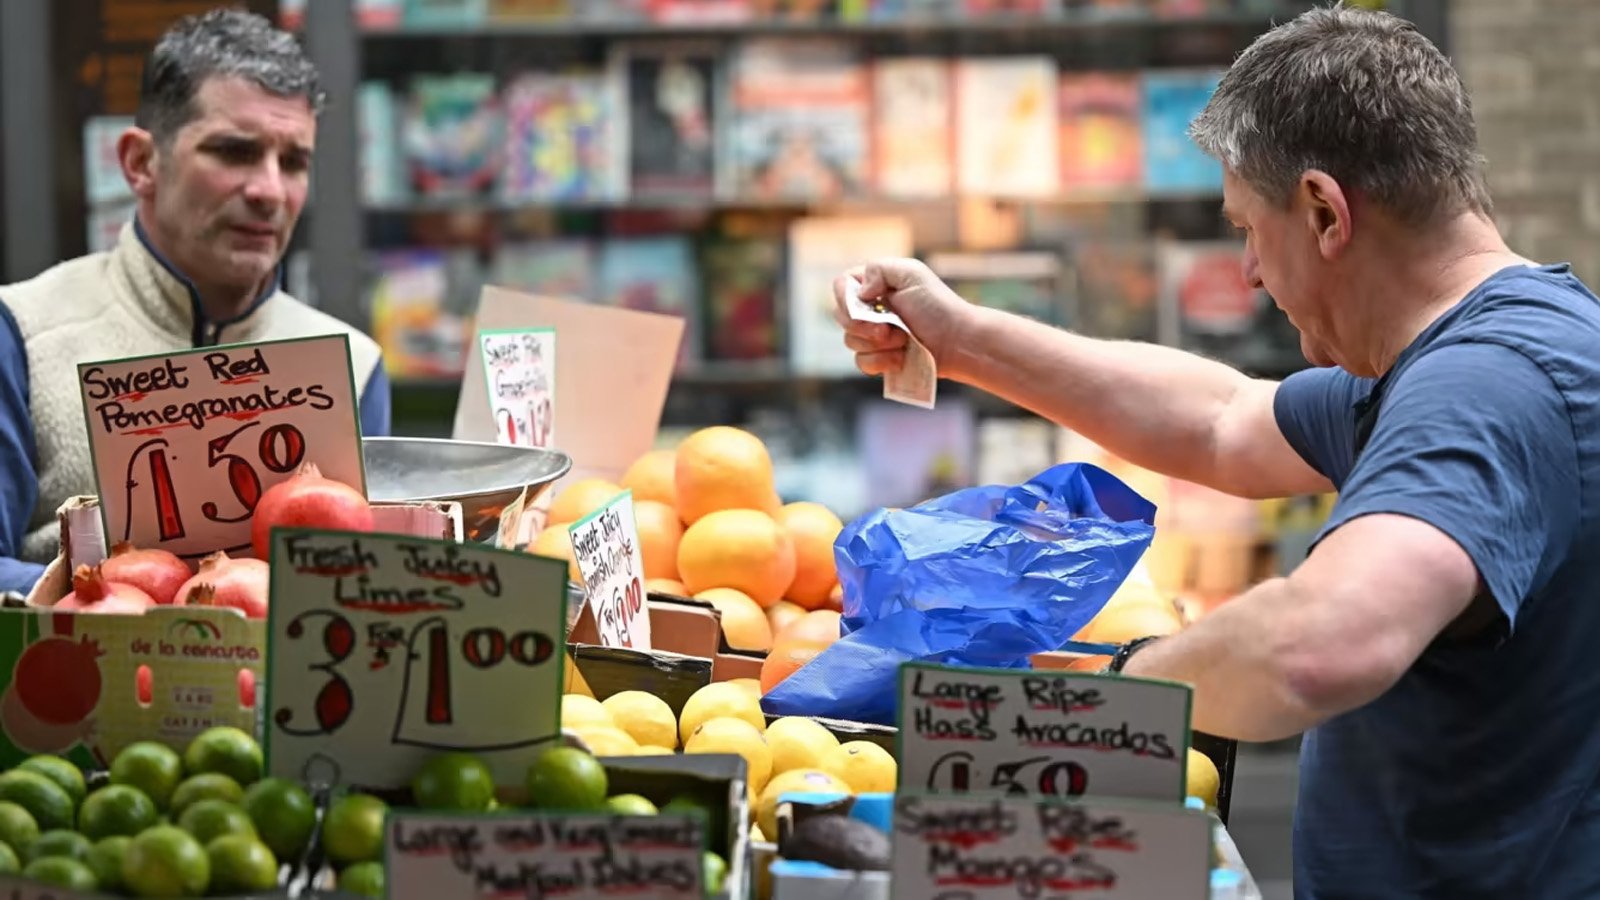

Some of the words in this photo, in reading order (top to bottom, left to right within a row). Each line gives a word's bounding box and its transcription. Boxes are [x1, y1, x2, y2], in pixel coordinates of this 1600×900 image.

[83, 358, 190, 400] Sweet
[203, 348, 270, 381] Red
[95, 383, 335, 433] Pomegranates
[573, 521, 601, 560] Sweet
[283, 535, 378, 569] Fresh
[395, 543, 503, 597] Juicy
[333, 576, 465, 611] Limes
[274, 608, 357, 737] 3
[910, 671, 1005, 720] Large
[1021, 677, 1107, 715] Ripe
[914, 705, 998, 741] Hass
[393, 819, 484, 874] Large
